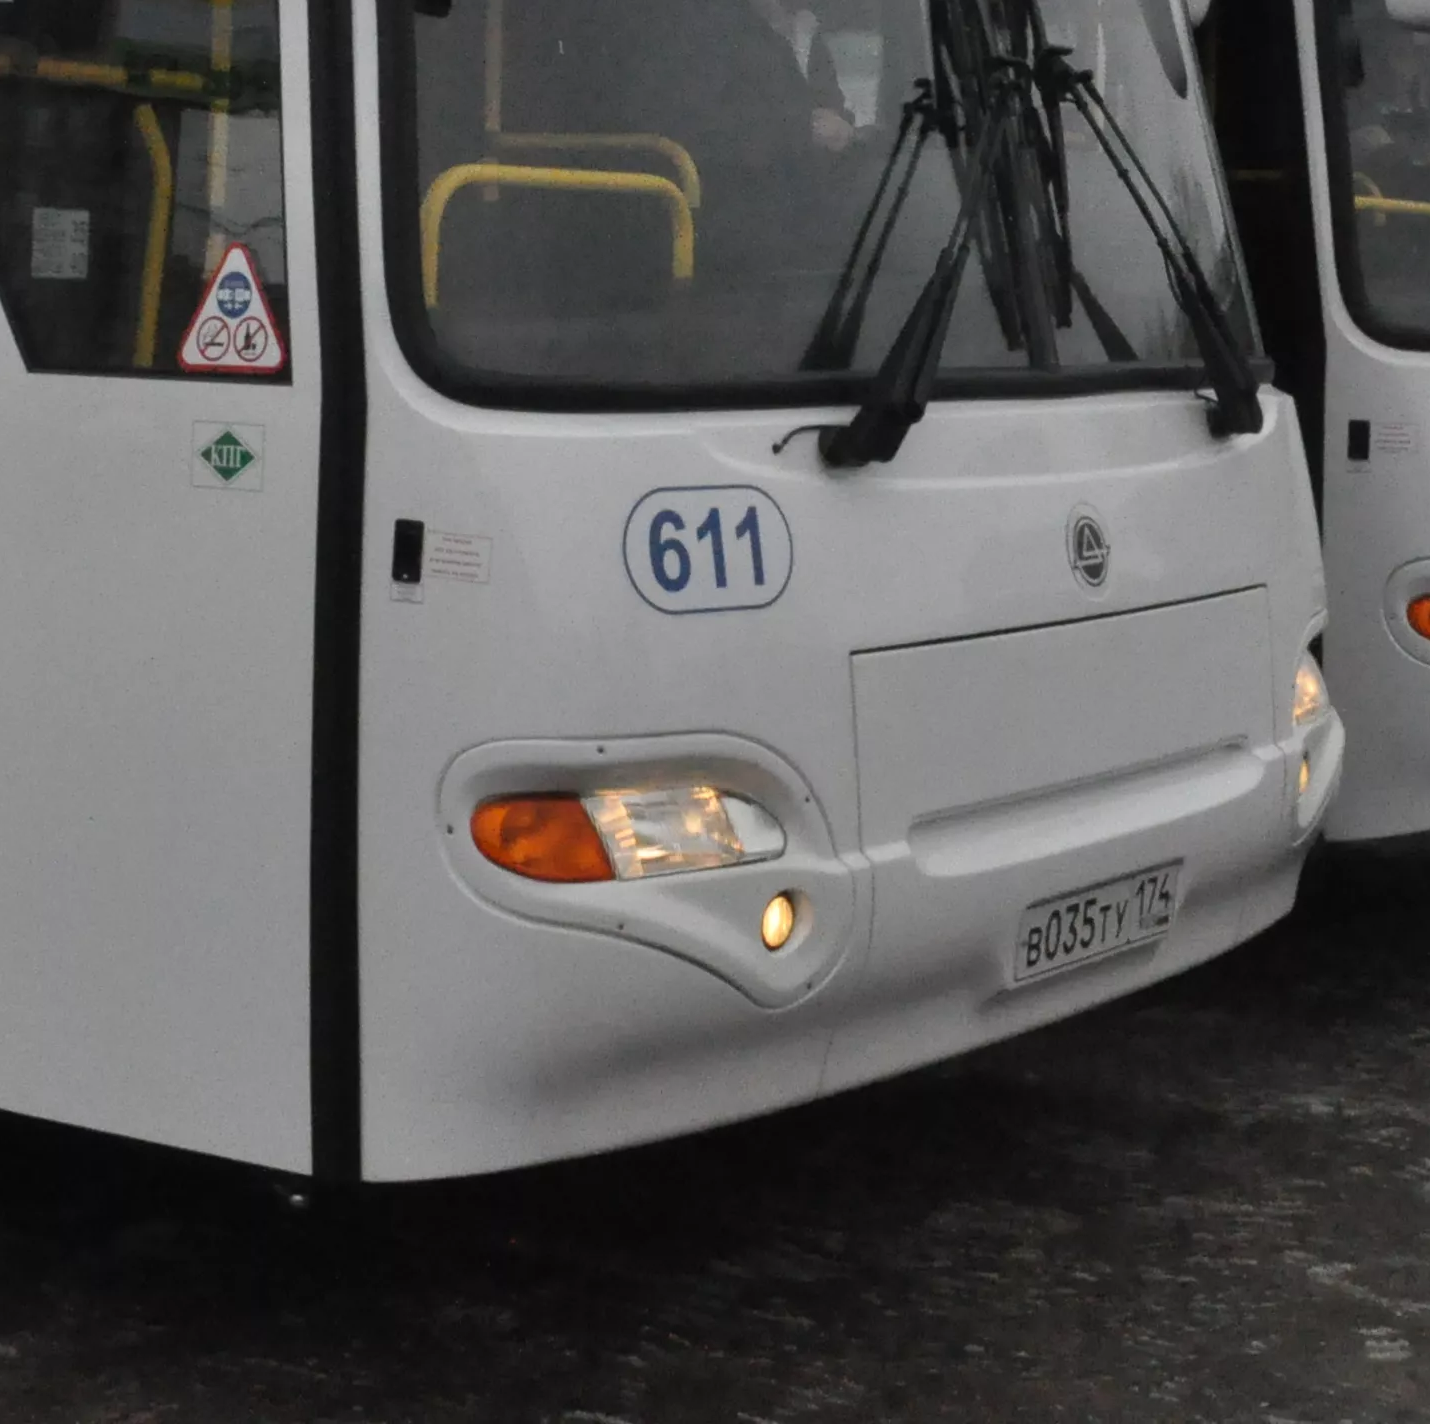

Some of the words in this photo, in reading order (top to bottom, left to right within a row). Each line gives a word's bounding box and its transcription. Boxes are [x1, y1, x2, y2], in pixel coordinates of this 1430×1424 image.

[211, 444, 248, 468] КПГ
[648, 504, 768, 593] 611
[1135, 873, 1172, 918] 174
